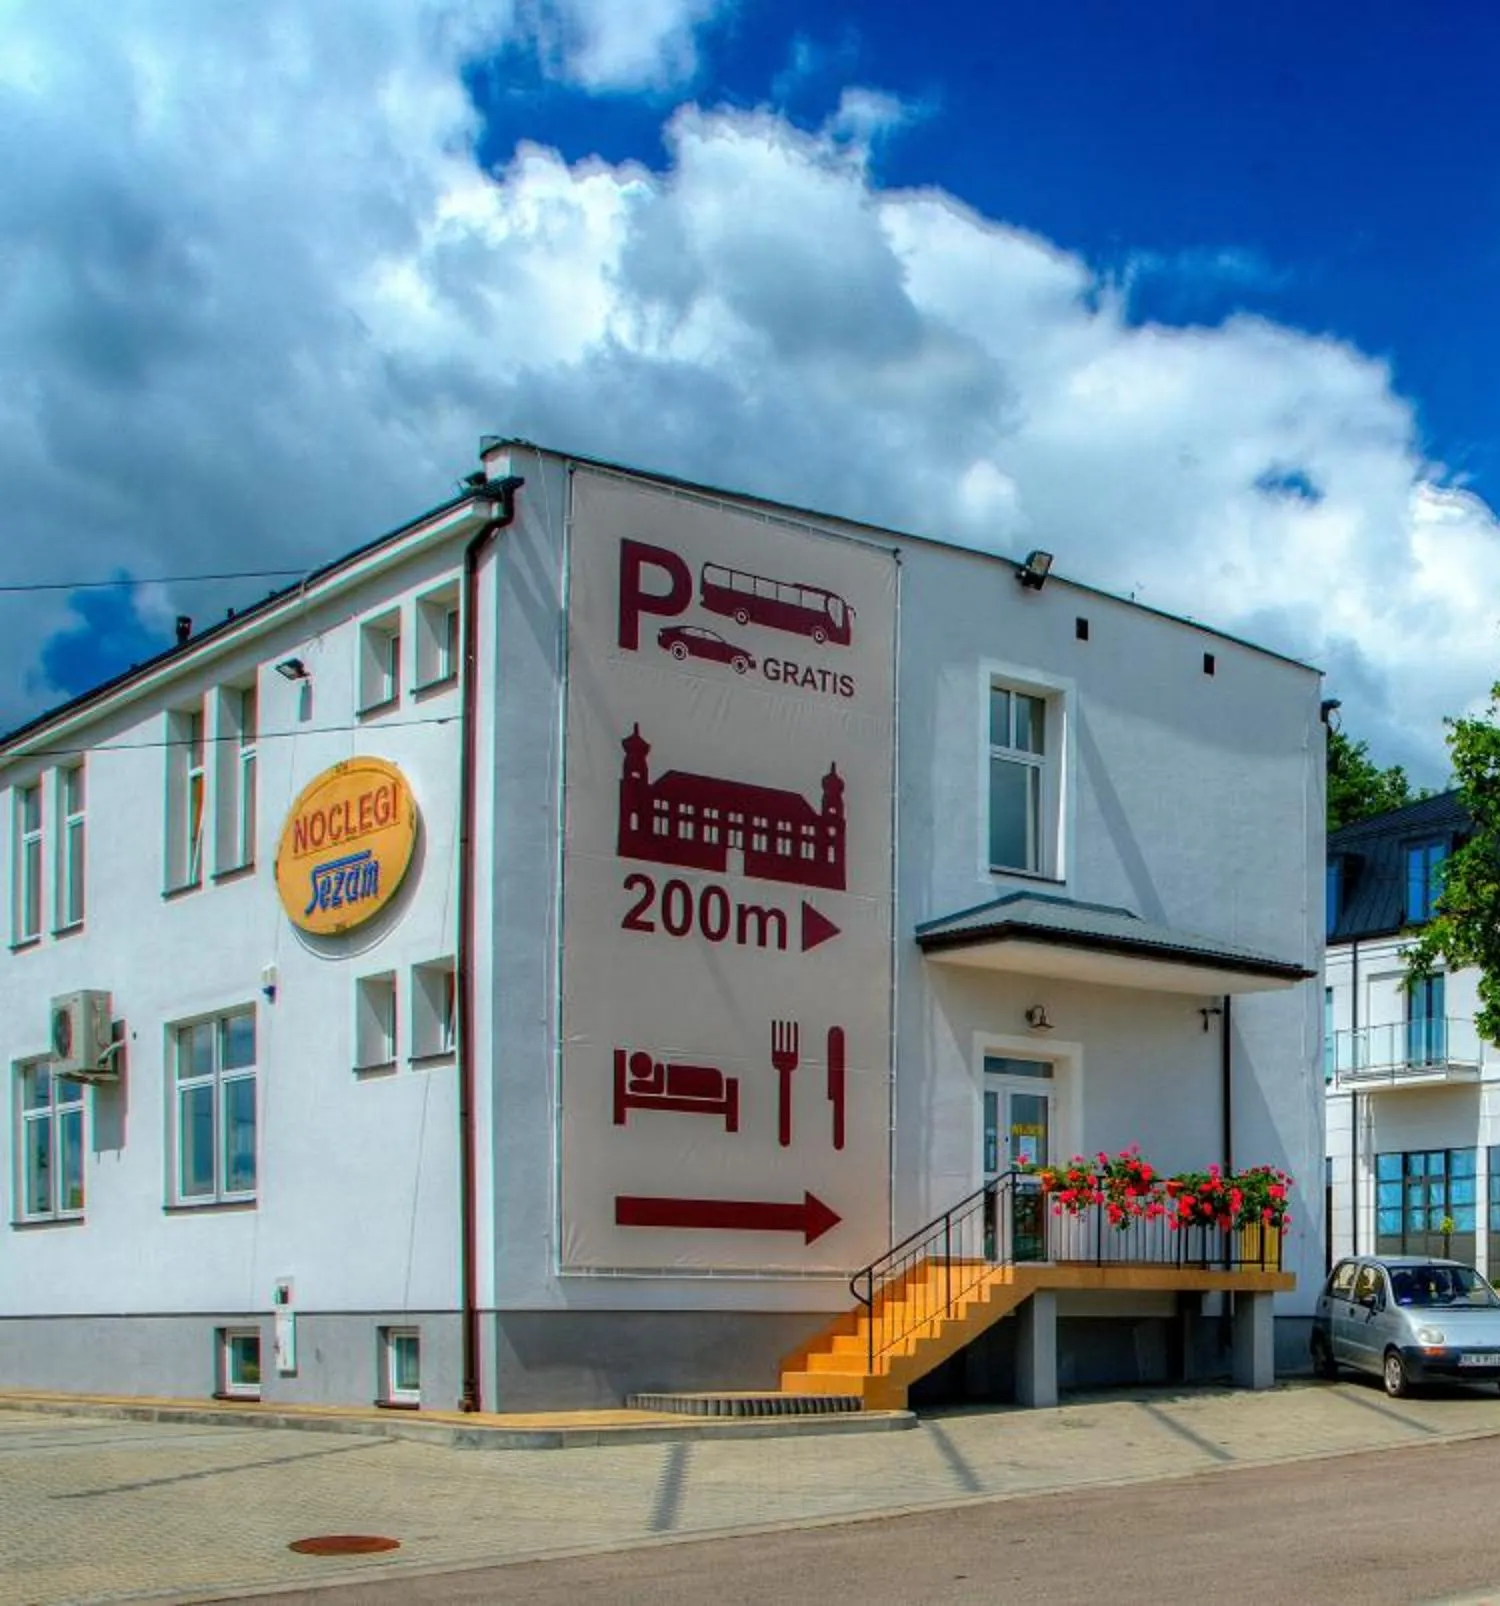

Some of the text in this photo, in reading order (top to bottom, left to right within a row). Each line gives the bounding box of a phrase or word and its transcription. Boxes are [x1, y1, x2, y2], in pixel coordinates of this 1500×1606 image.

[618, 537, 692, 651] P
[763, 657, 854, 697] GRATIS
[293, 783, 397, 853] NOCLEGI
[304, 850, 379, 917] Sezam
[621, 873, 787, 950] 200m
